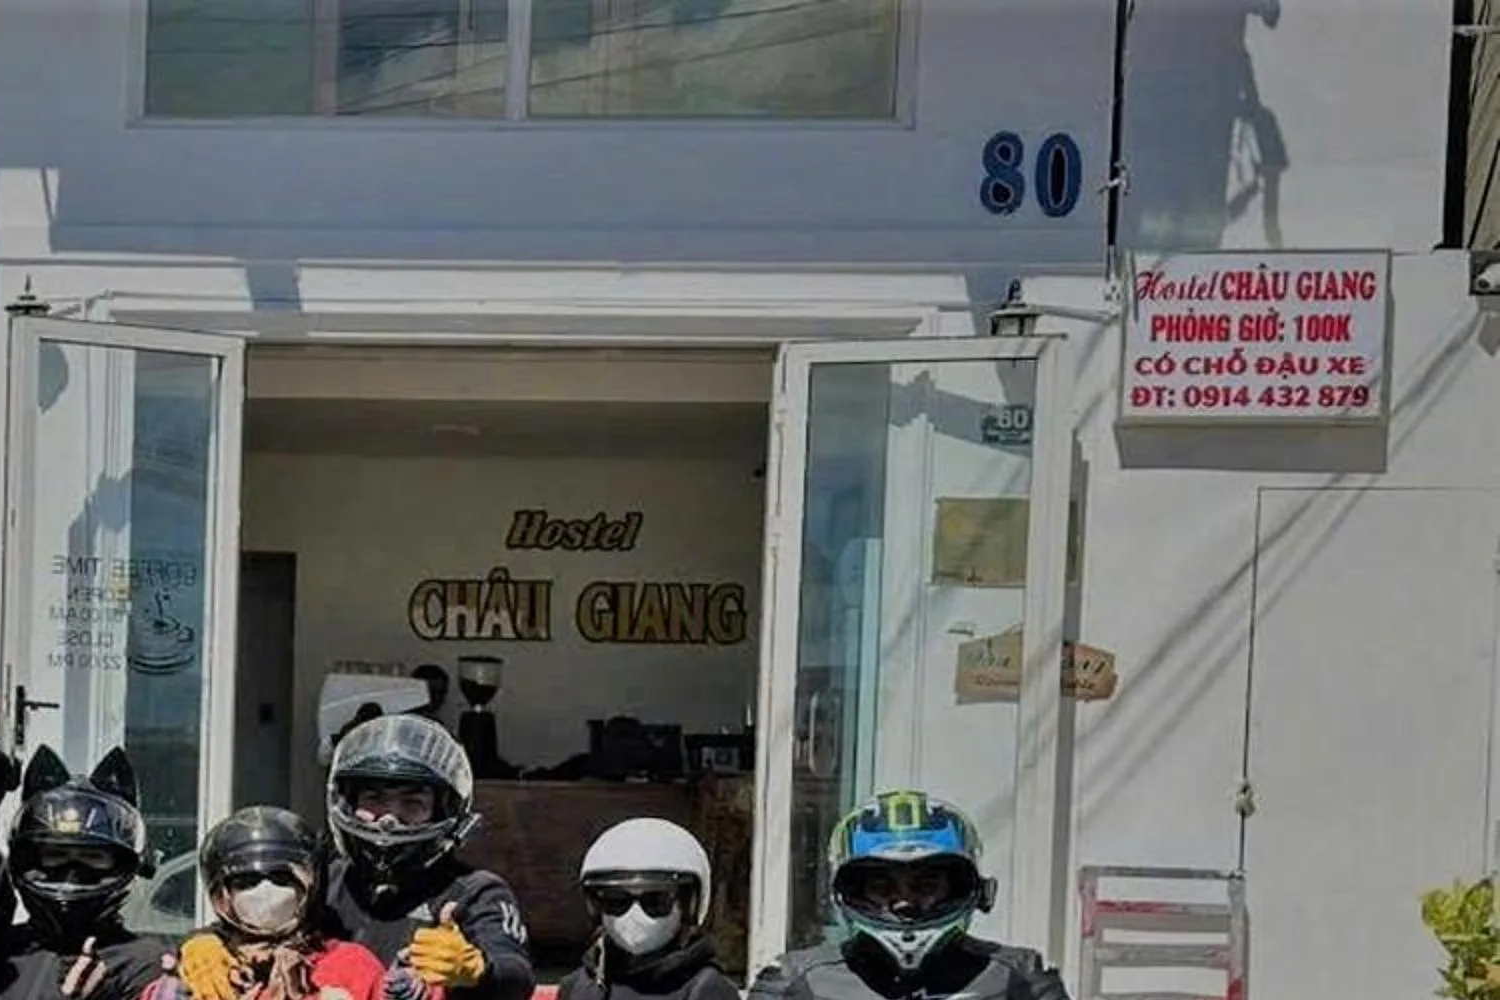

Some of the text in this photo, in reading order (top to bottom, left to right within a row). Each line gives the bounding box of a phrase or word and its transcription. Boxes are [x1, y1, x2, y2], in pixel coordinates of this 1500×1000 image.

[979, 130, 1083, 218] 80
[1134, 262, 1377, 302] Hostel CHÂU GIANG
[1293, 313, 1352, 343] 100K
[1134, 347, 1366, 380] CÓ CHỖ ĐẬU XE
[1130, 384, 1371, 409] ĐT: 0914 432 879
[506, 509, 644, 551] Hostel
[408, 566, 748, 645] CHÂU GIANG
